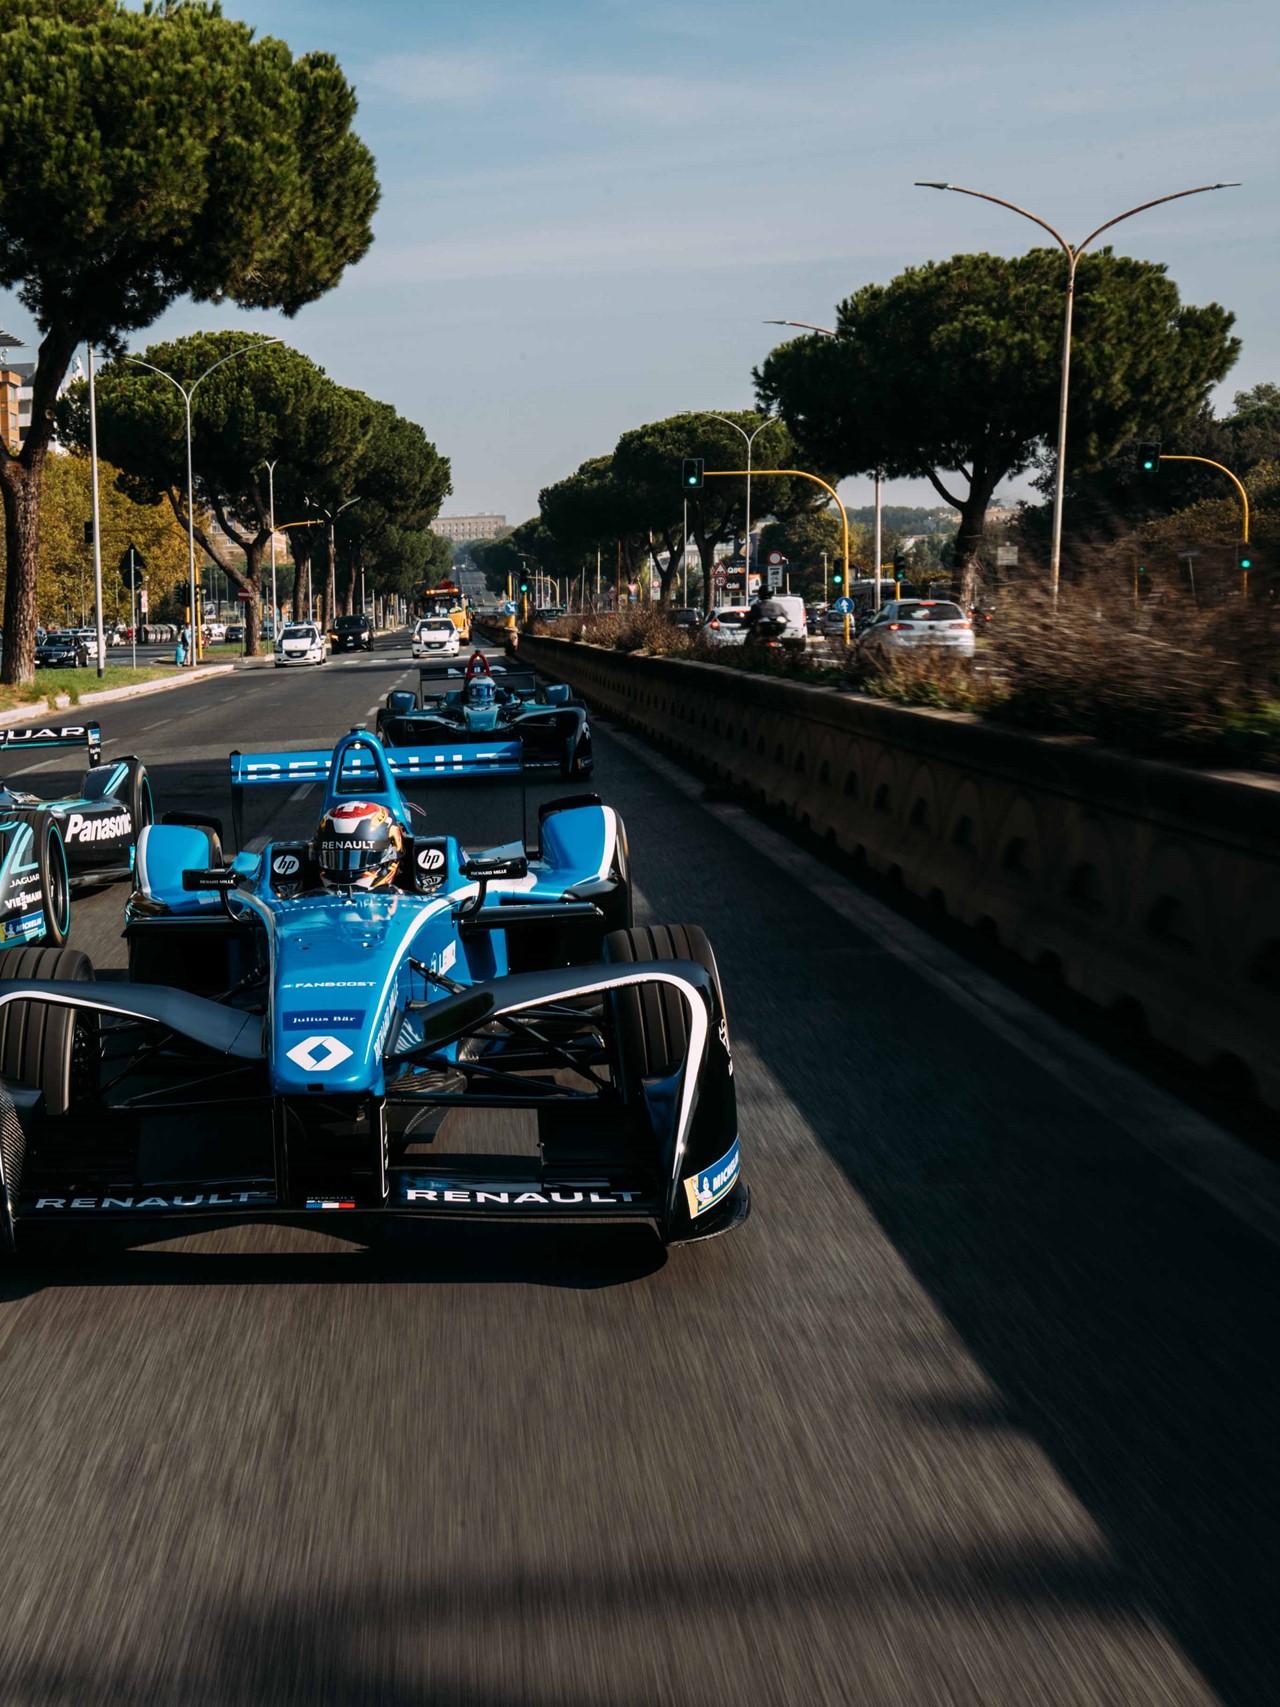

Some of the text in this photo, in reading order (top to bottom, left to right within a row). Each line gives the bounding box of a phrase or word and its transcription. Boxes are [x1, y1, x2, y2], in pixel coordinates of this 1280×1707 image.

[64, 811, 132, 843] Panasonic
[322, 840, 375, 849] RENAULT
[277, 854, 297, 875] hp
[421, 848, 442, 869] hp
[9, 873, 40, 888] JAGUAR
[295, 981, 377, 989] FANBOOST
[292, 1016, 329, 1024] Julius
[35, 1191, 265, 1209] RENAULT
[406, 1189, 643, 1203] RENAULT
